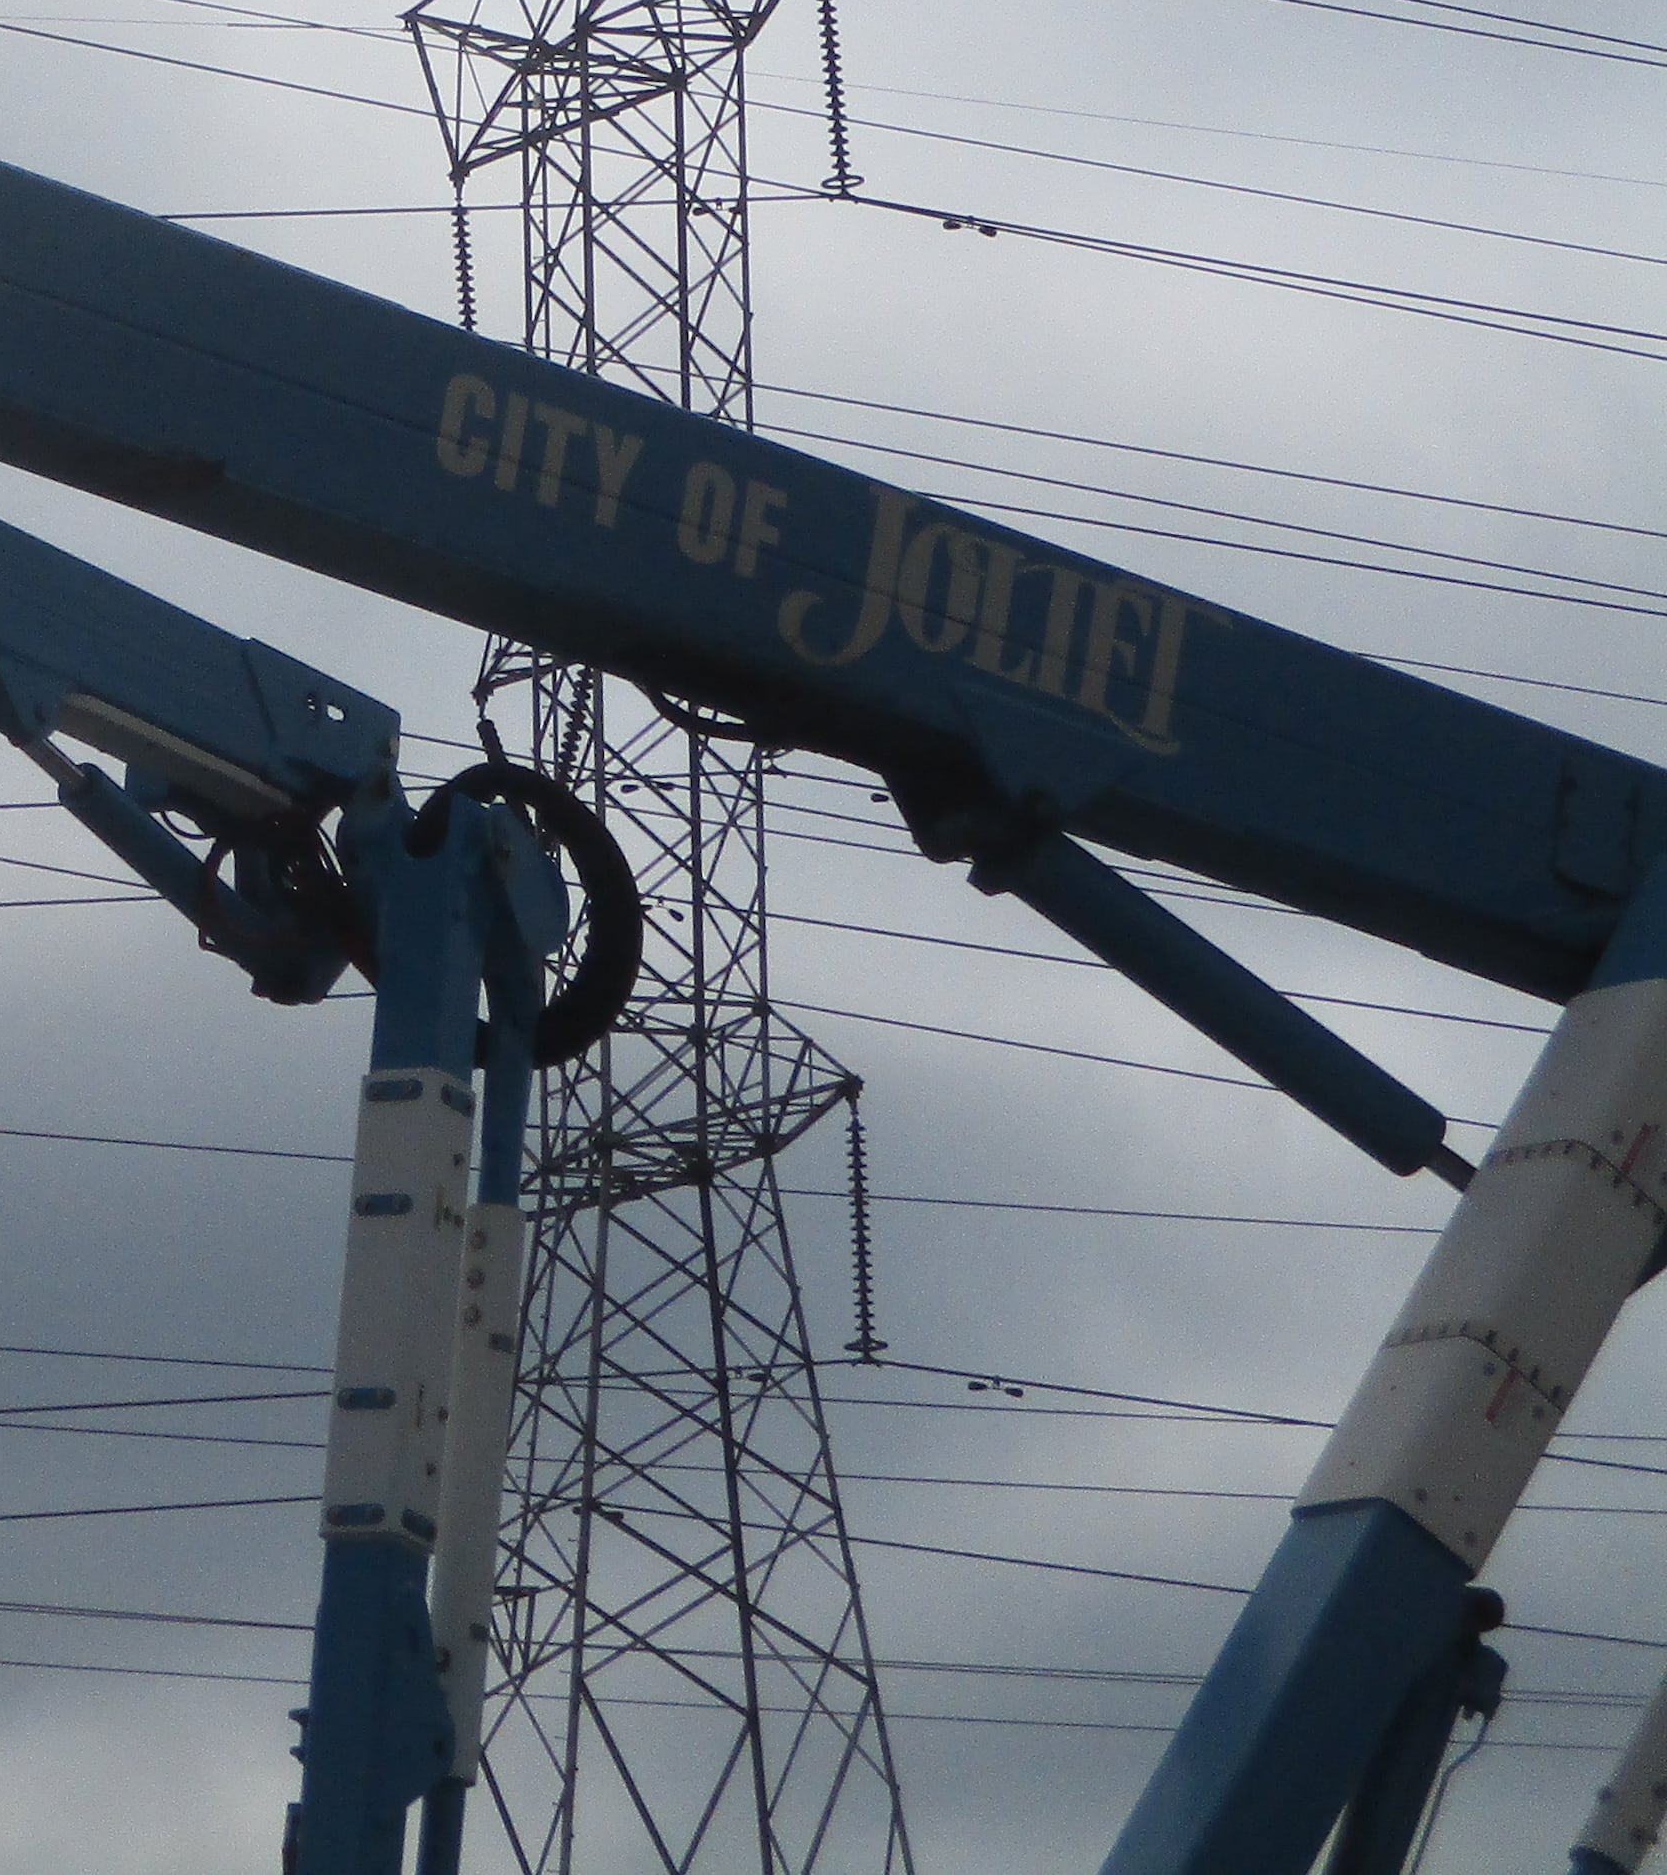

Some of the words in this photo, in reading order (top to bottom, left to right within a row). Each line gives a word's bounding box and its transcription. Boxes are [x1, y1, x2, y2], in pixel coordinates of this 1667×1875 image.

[434, 373, 646, 529] CITY
[675, 461, 790, 579] OF
[776, 481, 1235, 757] JOLIET
